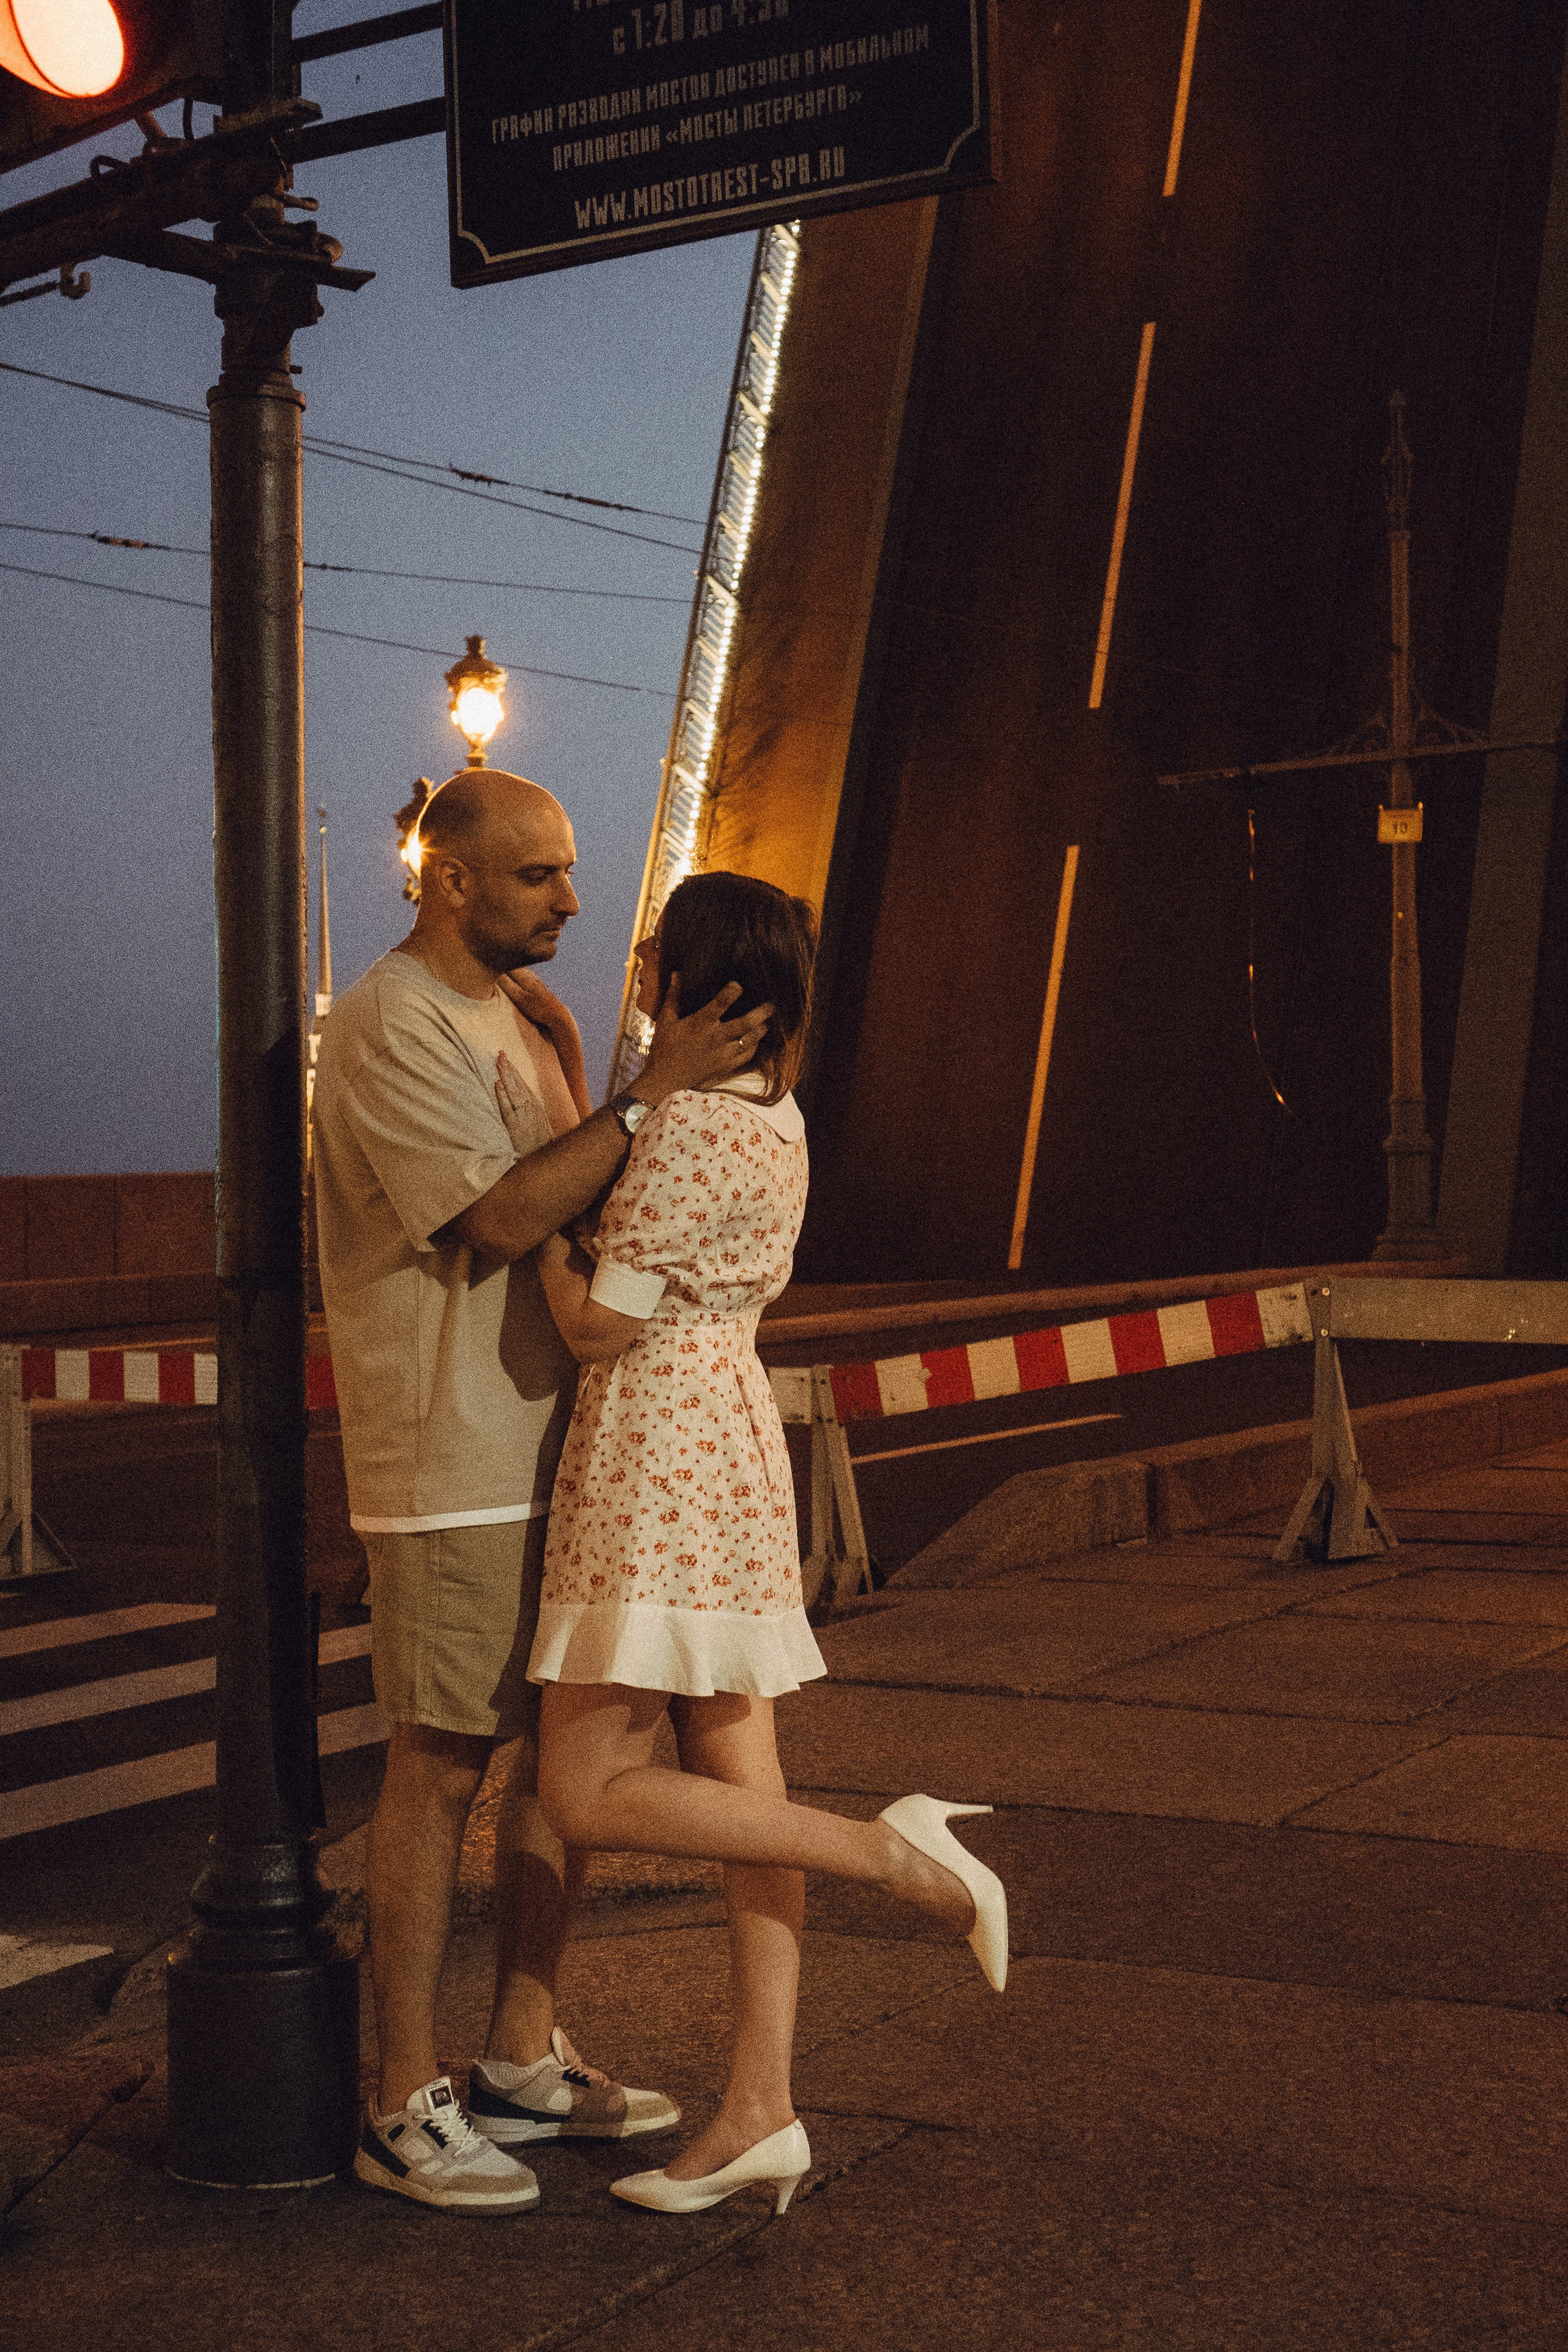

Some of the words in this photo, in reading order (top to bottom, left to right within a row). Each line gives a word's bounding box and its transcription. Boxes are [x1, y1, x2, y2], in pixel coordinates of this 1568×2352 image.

[612, 26, 625, 55] с
[631, 0, 684, 50] 1:20
[693, 5, 723, 39] до
[492, 107, 552, 144] ГРАФИК
[558, 88, 641, 129] РАЗВОДКИ
[646, 73, 710, 111] МОСТОВ
[715, 53, 799, 98] ДОСТУПЕН
[805, 49, 815, 76] В
[820, 24, 929, 74] МОБИЛЬНОМ
[553, 124, 661, 172] ПРИЛОЖЕНИИ
[666, 108, 737, 145] «МОСТЫ
[743, 85, 862, 131] ПЕТЕРБУРГА»
[575, 145, 845, 230] WWW.MOSTOTREST-SPB.RU
